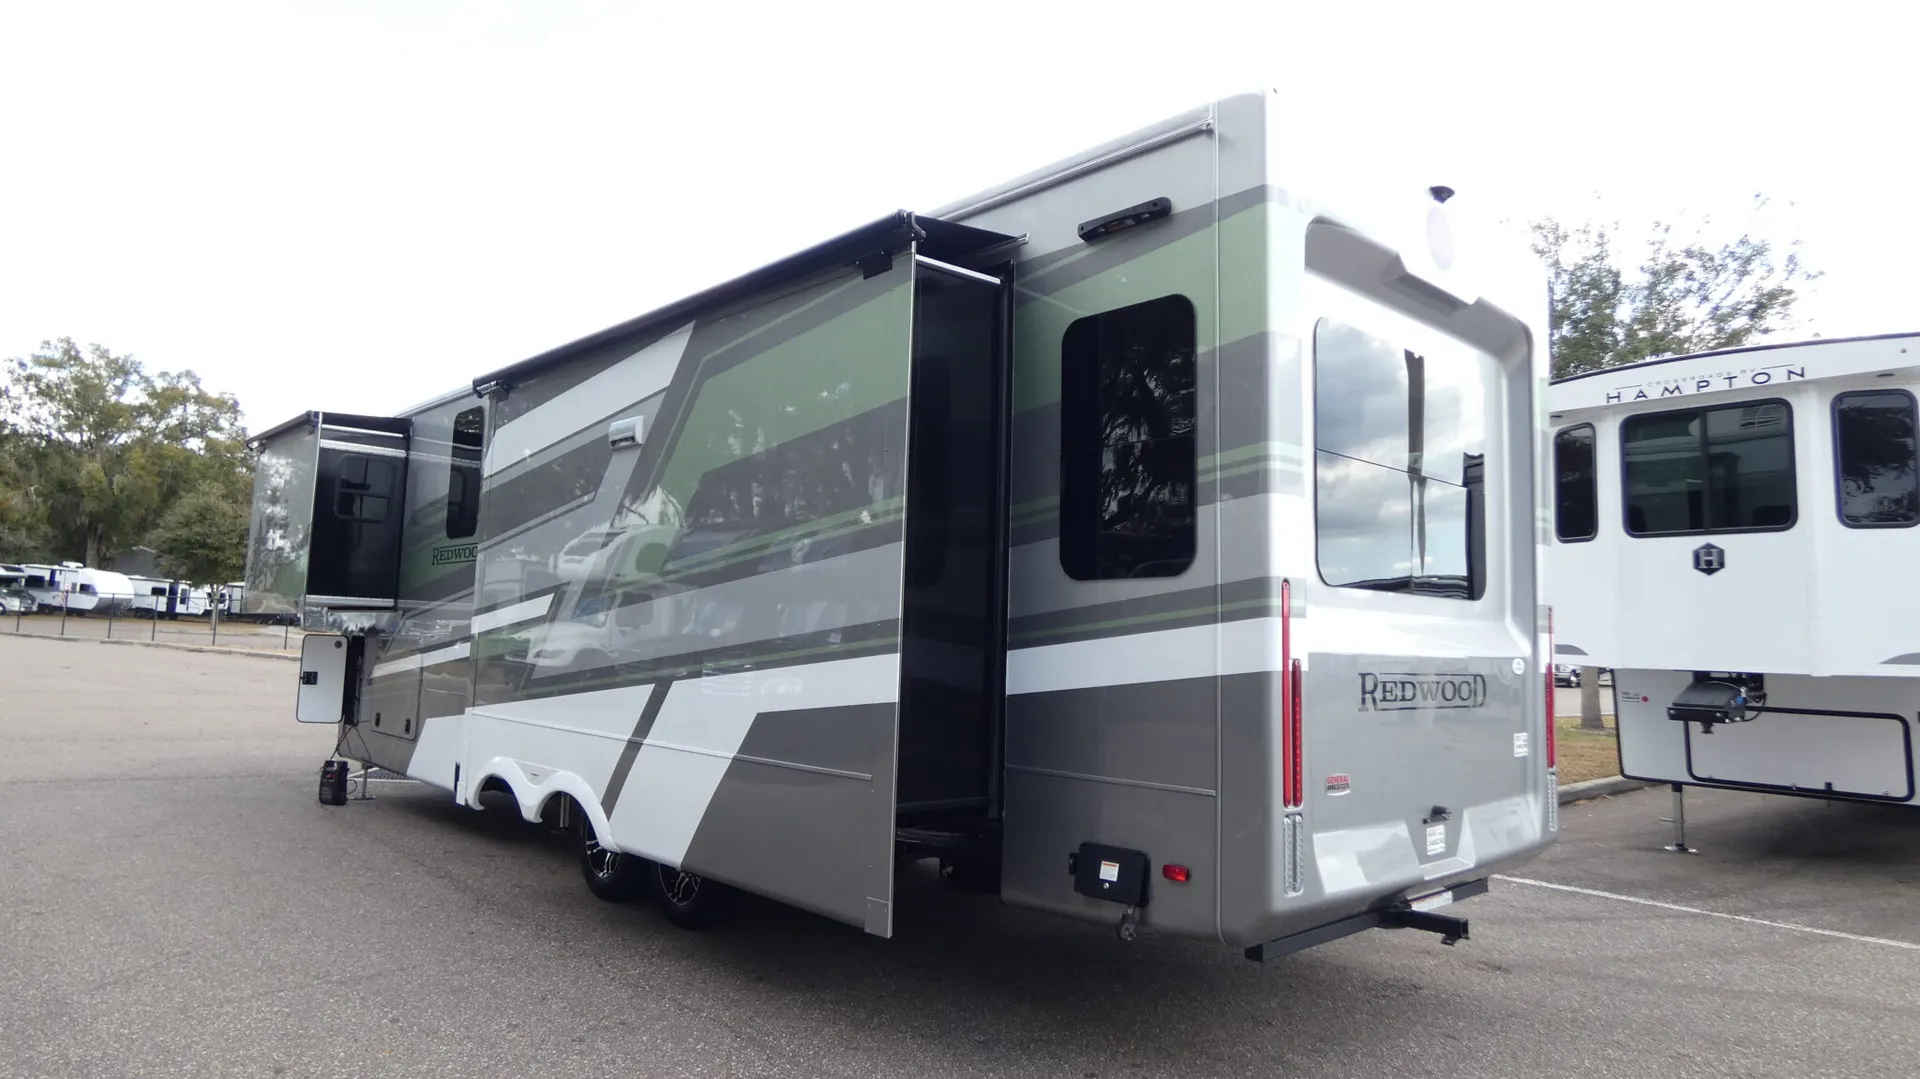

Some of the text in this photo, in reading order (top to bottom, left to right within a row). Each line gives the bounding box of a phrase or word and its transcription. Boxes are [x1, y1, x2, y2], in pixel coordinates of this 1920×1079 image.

[1606, 366, 1805, 404] HAMPTON
[1646, 371, 1732, 388] CROSSROADS
[431, 545, 478, 566] REDWOO
[1358, 672, 1487, 712] REDWOOD
